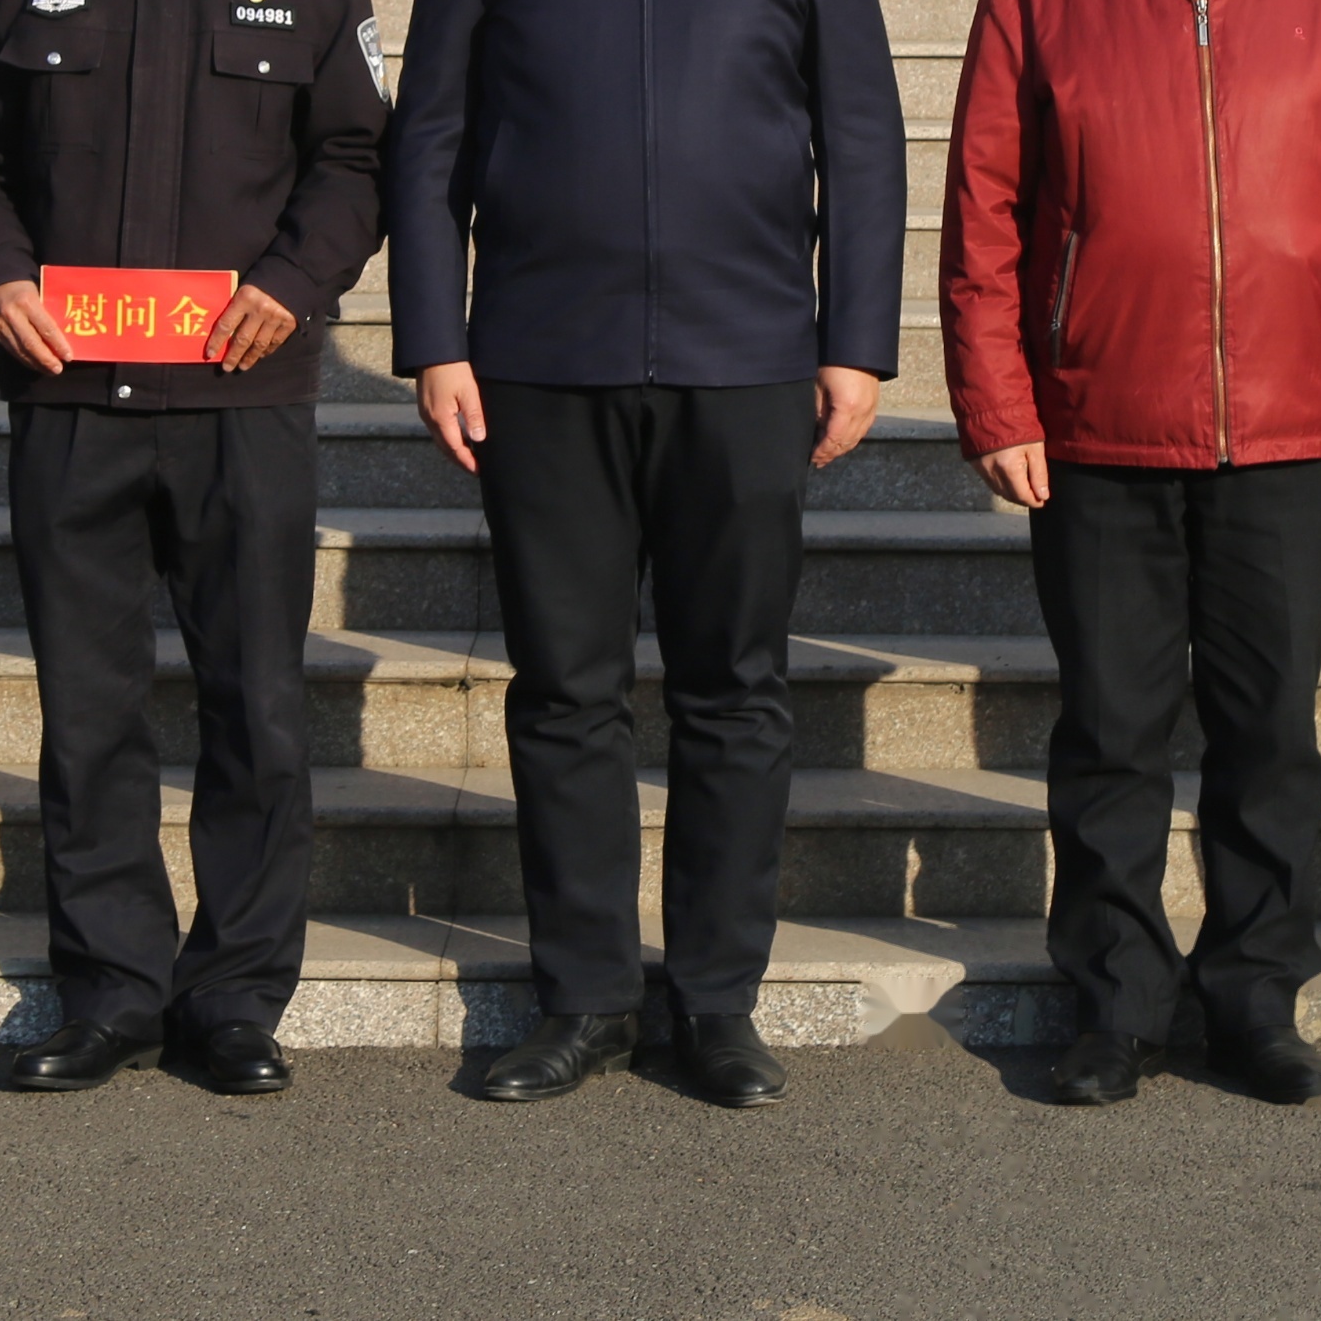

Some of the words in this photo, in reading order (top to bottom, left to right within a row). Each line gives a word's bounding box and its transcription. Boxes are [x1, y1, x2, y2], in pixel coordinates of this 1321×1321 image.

[236, 5, 294, 26] 094981
[64, 293, 210, 338] 慰问金
